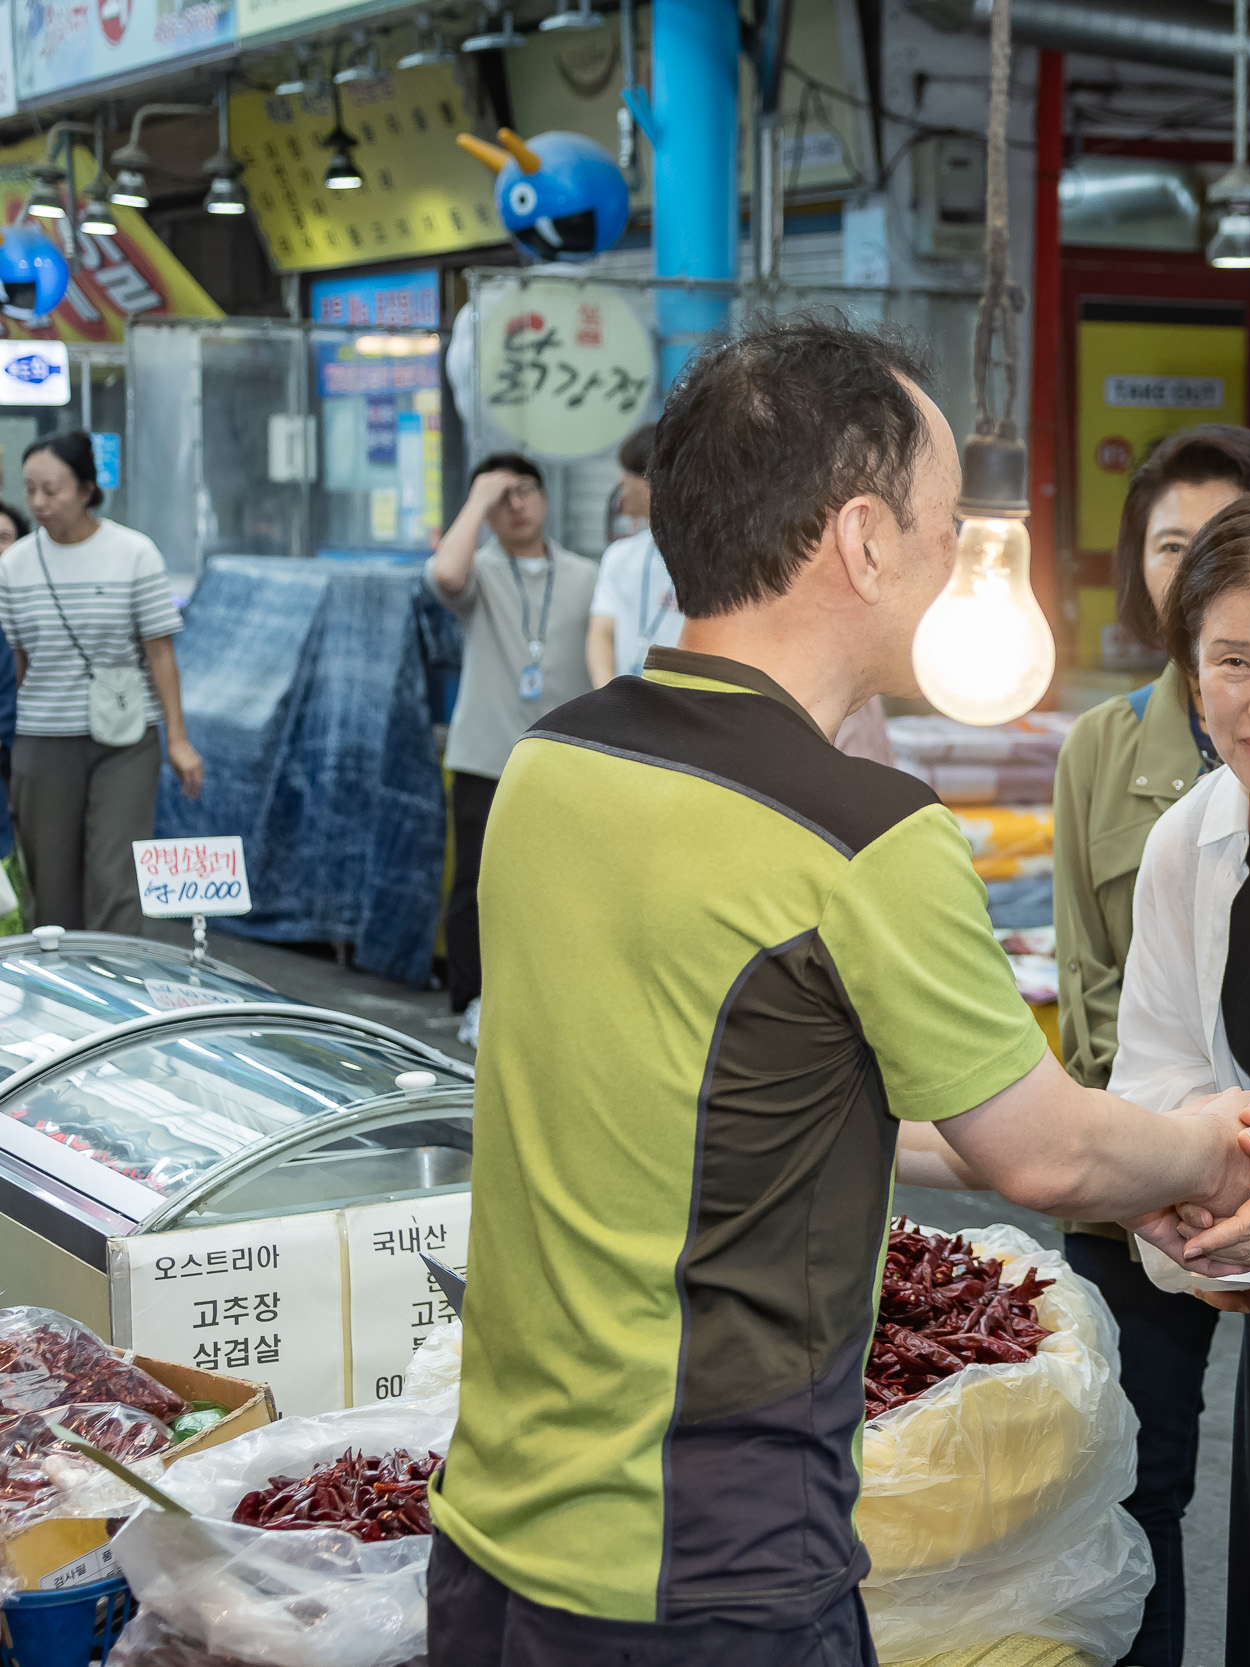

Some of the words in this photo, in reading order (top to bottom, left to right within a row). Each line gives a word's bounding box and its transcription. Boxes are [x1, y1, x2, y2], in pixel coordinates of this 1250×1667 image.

[488, 312, 650, 412] 닭강정
[1114, 379, 1165, 401] TAKE
[1171, 380, 1216, 400] OUT
[373, 1223, 447, 1256] 국내산
[154, 1244, 280, 1281] 오스트리아
[192, 1291, 281, 1329] 고추장
[192, 1333, 281, 1371] 삼겹살
[376, 1373, 405, 1400] 60
